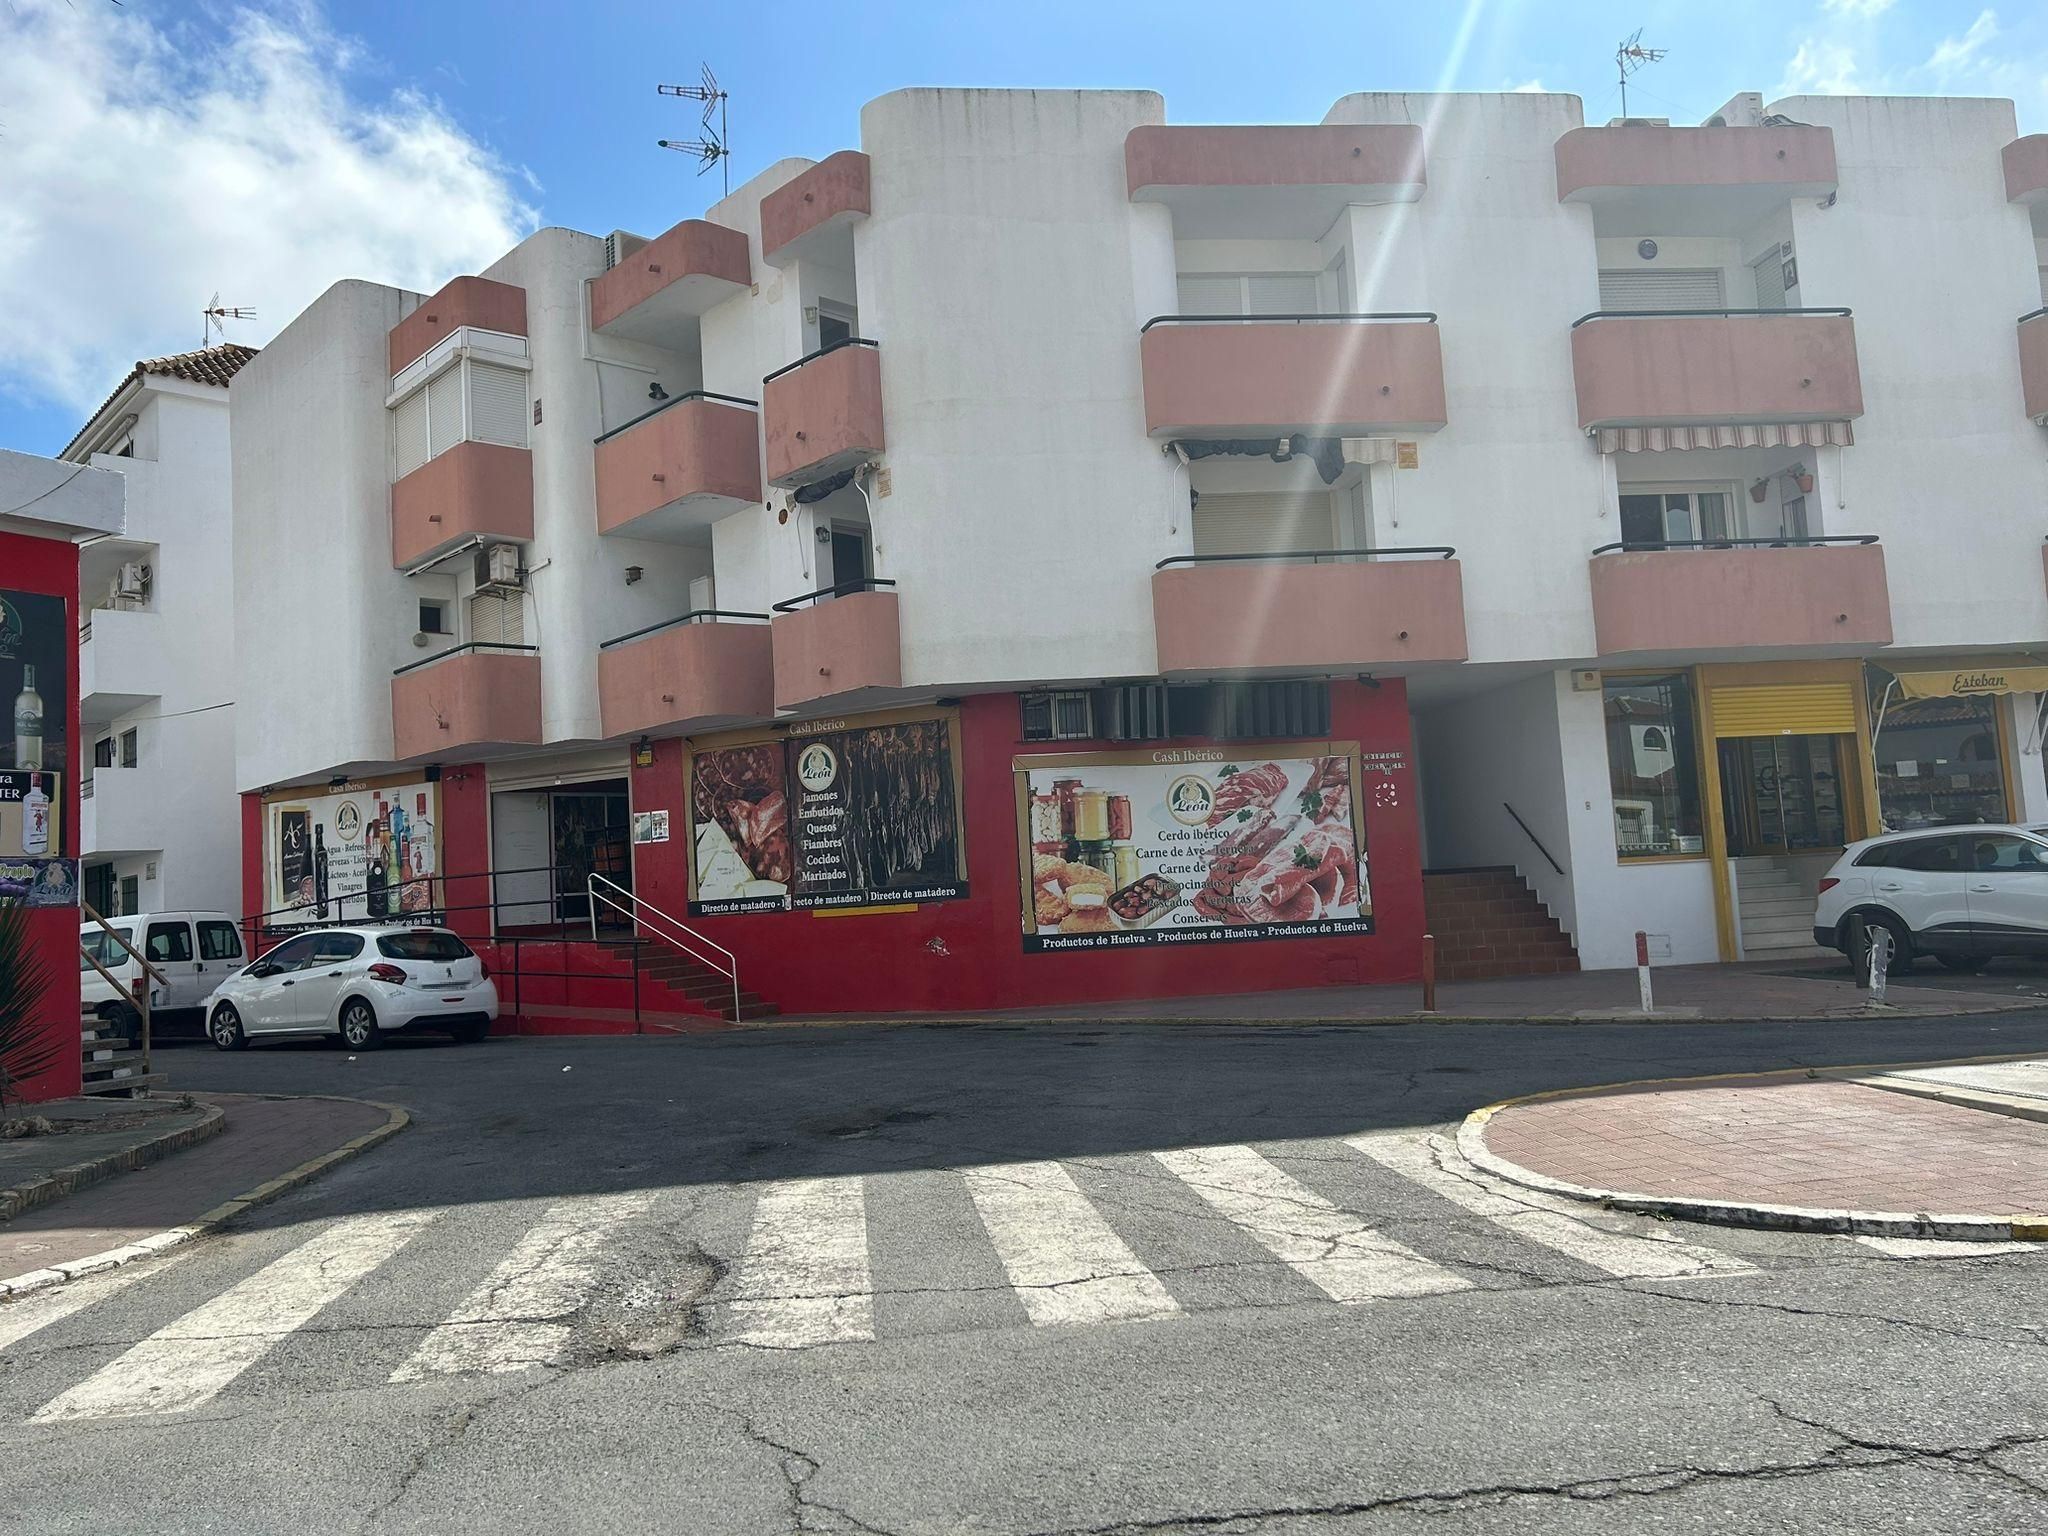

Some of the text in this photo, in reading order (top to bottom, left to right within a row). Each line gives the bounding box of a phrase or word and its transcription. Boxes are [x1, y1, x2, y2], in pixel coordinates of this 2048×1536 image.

[1953, 674, 2006, 692] Esteban
[790, 719, 845, 734] Cash Ibérico
[1152, 749, 1224, 763] Cash Ibérico
[804, 768, 831, 779] León
[803, 791, 838, 804] Jamones
[799, 805, 844, 819] Embutidos
[1173, 800, 1209, 812] León
[338, 821, 357, 830] León
[807, 823, 837, 835] Quesos
[1158, 828, 1230, 841] Cerdo ibérico
[803, 838, 842, 850] Fiambres
[1135, 847, 1168, 858] Carne
[1170, 846, 1183, 857] de
[1186, 845, 1205, 856] Ave
[327, 859, 350, 867] ervezas
[807, 854, 841, 866] Cocidos
[1159, 863, 1191, 874] Carne
[1193, 862, 1206, 873] de
[802, 869, 846, 881] Marinados
[337, 882, 362, 892] Vinagres
[701, 903, 728, 913] Directo
[730, 902, 739, 911] de
[740, 901, 776, 911] matadero
[815, 896, 824, 905] de
[825, 894, 862, 904] matadero
[871, 890, 900, 901] Directo
[903, 889, 912, 899] de
[914, 887, 956, 898] matadero
[1172, 913, 1227, 925] Conservas
[1042, 937, 1094, 948] Productos
[1096, 935, 1108, 945] de
[1110, 933, 1146, 945] Huelva
[1157, 931, 1207, 942] Productos
[1210, 930, 1221, 940] de
[1224, 928, 1259, 939] Huelva
[1267, 925, 1318, 936] Productos
[1320, 923, 1332, 933] de
[1334, 921, 1368, 932] Huelva
